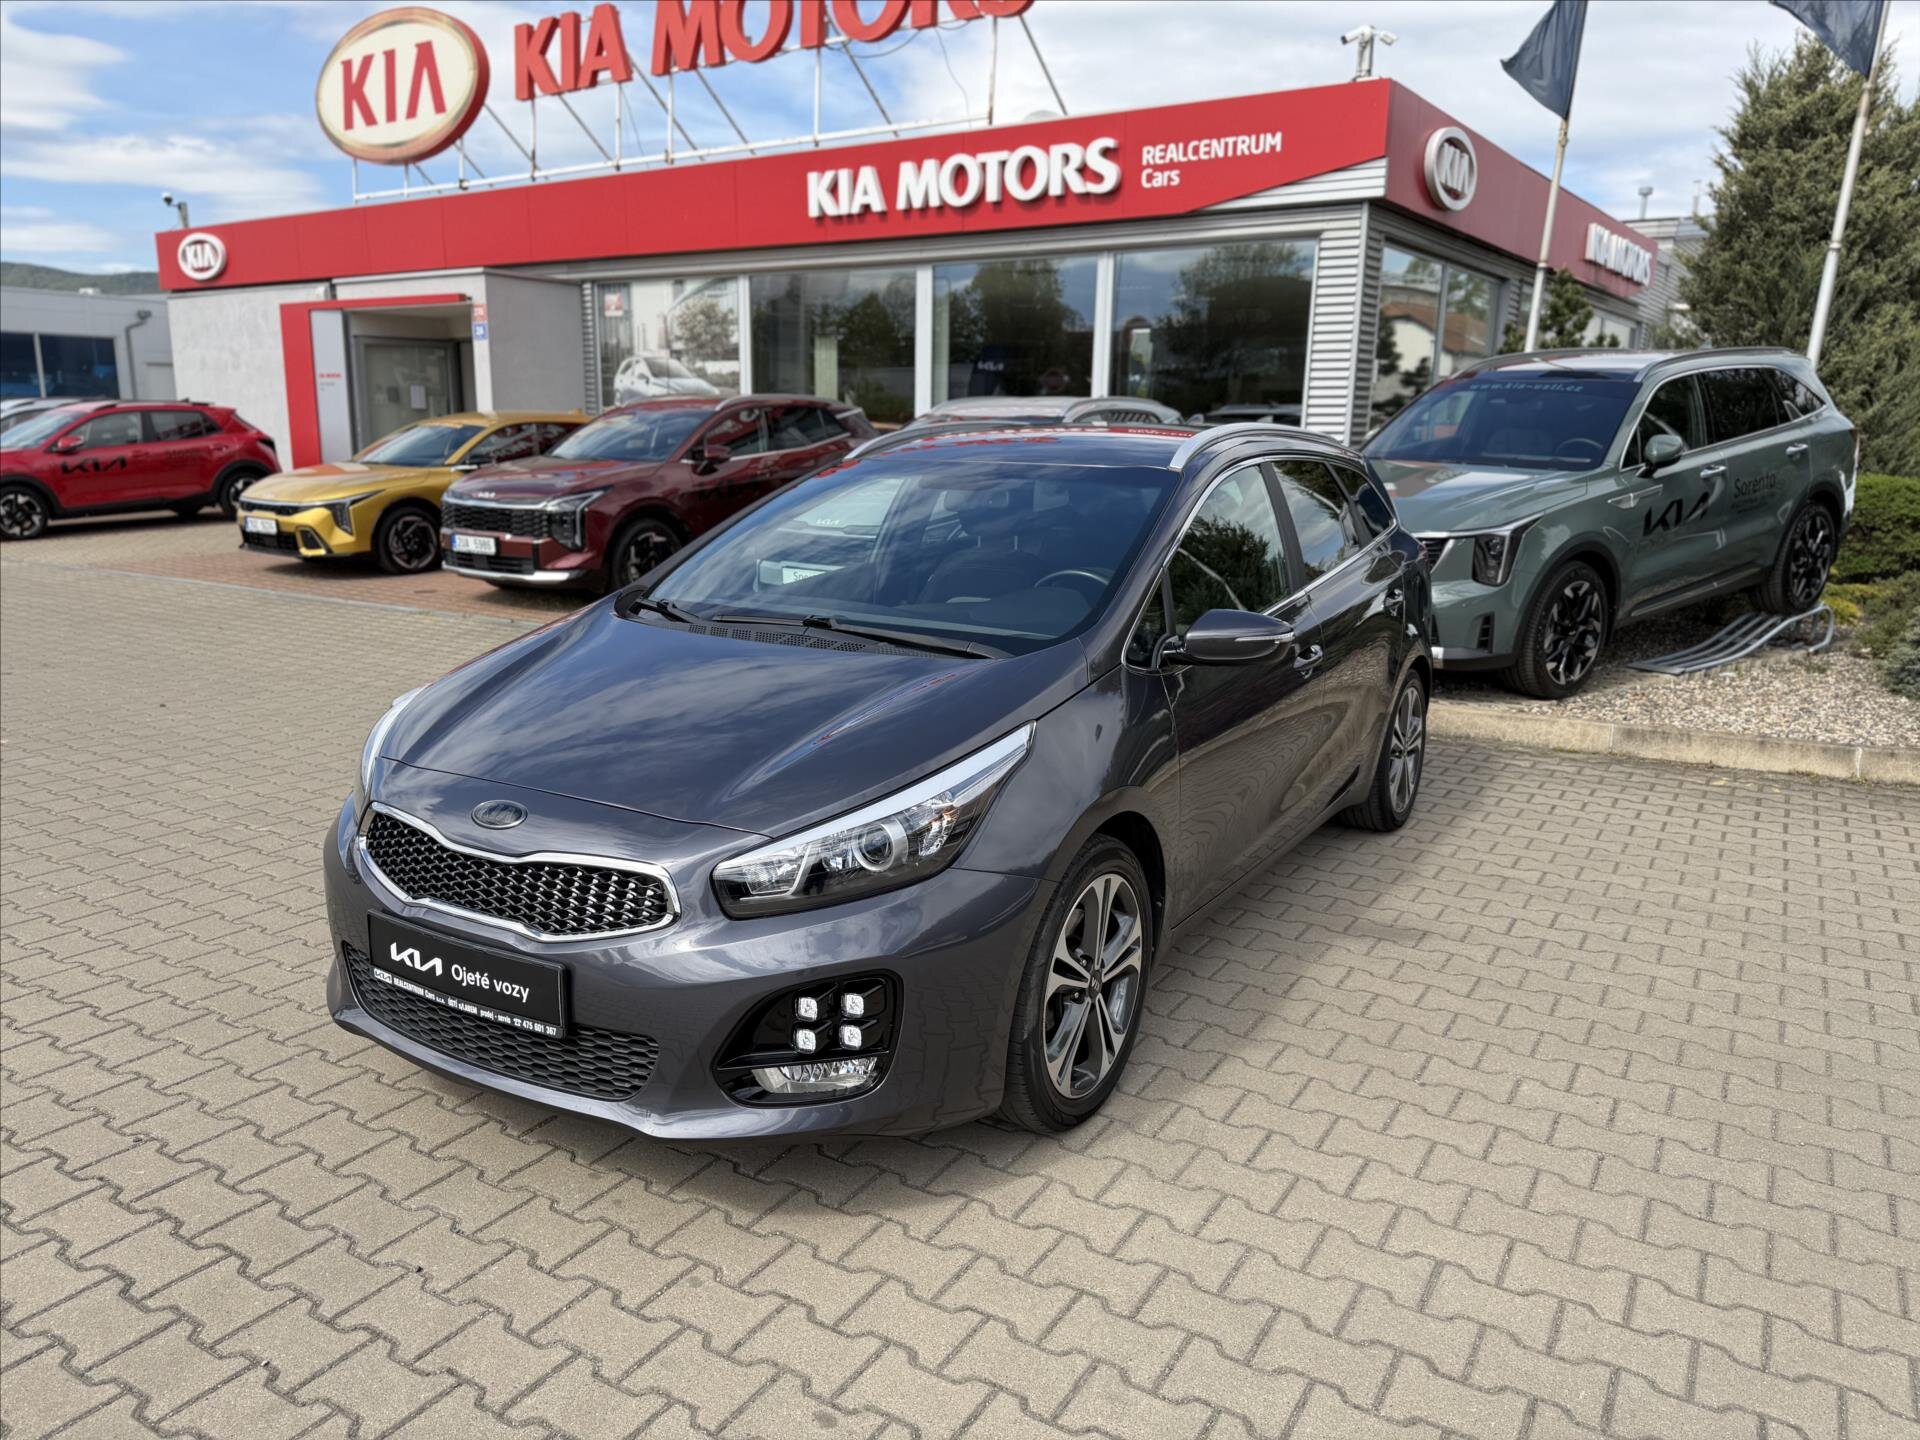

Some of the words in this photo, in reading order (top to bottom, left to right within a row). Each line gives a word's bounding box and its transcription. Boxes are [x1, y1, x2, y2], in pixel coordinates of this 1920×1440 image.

[513, 3, 634, 102] KIA
[340, 40, 447, 132] KIA
[1141, 131, 1283, 166] REALCENTRUM
[1438, 141, 1470, 195] KIA
[807, 165, 886, 218] KIA
[896, 137, 1121, 213] MOTORS
[1141, 167, 1181, 189] Cars
[185, 243, 217, 270] KIA
[60, 455, 128, 475] KIA
[1642, 491, 1710, 537] KIA
[390, 941, 443, 977] KIA
[451, 963, 490, 990] Ojeté
[493, 978, 530, 1003] vozy
